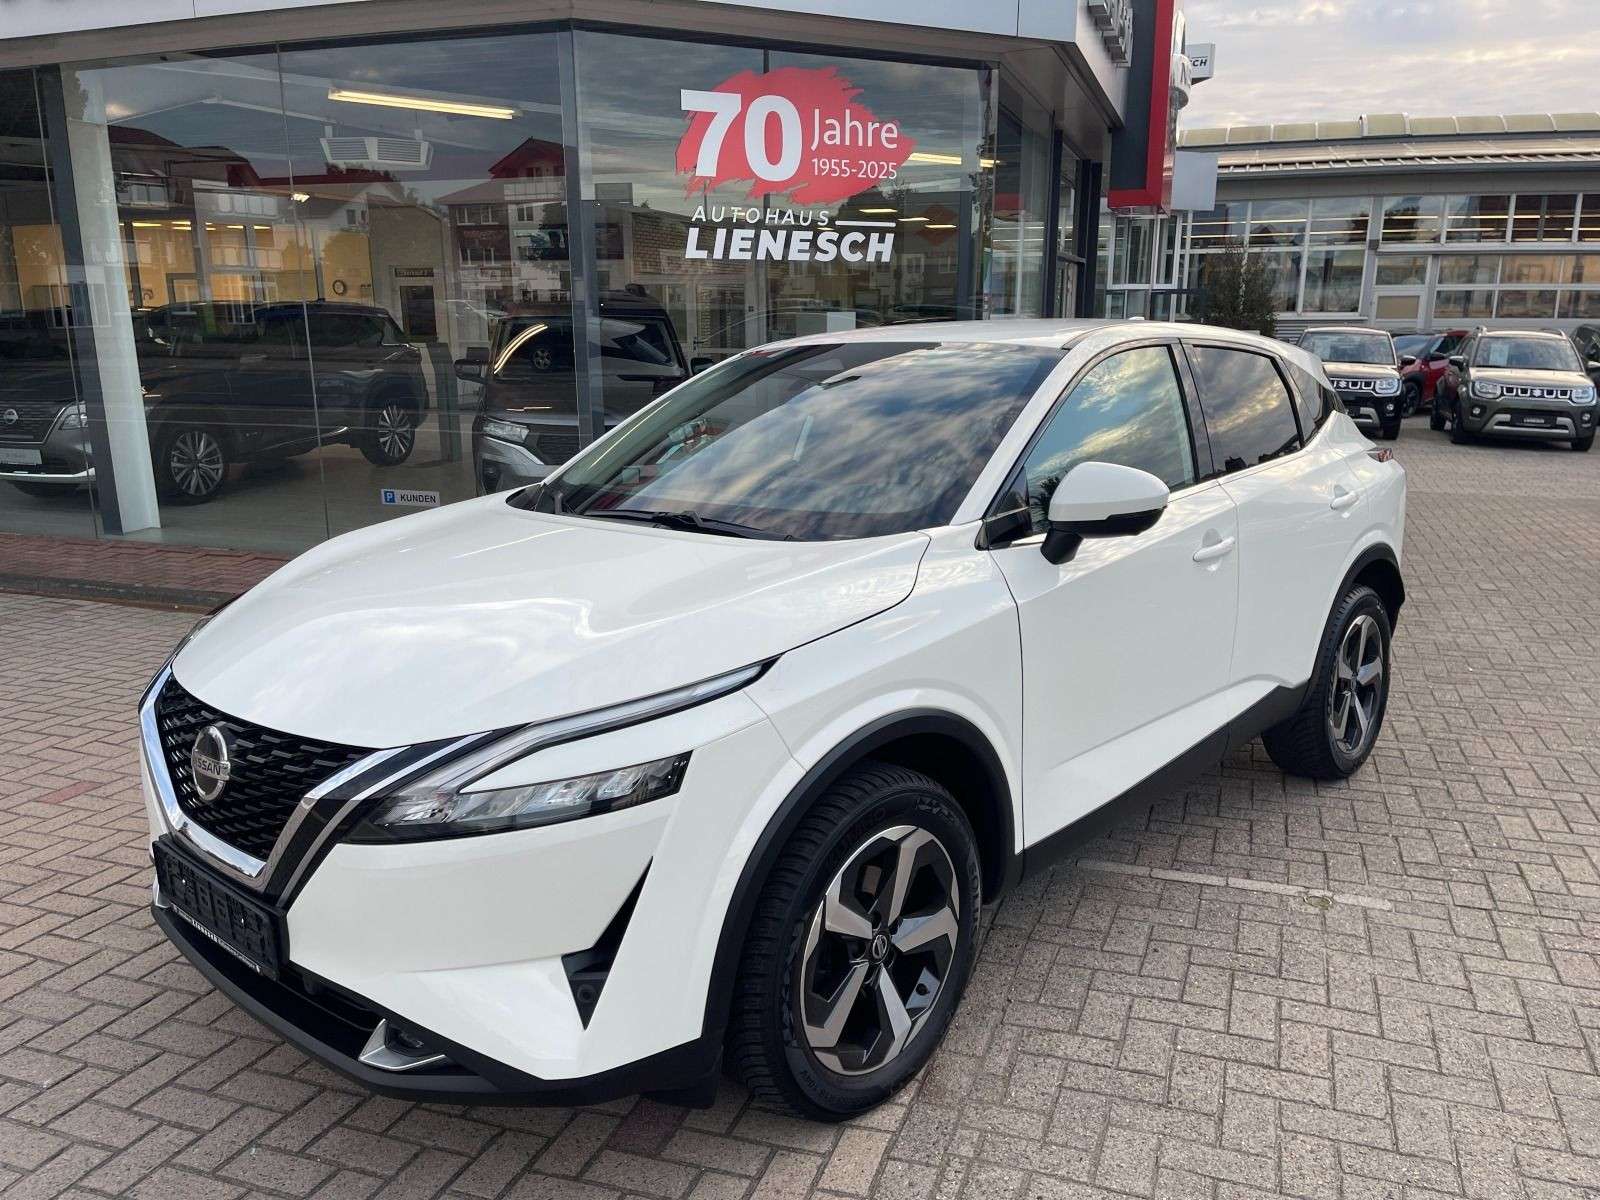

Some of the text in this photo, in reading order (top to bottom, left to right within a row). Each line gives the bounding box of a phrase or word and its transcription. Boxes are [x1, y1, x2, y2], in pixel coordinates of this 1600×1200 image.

[681, 88, 802, 182] 70
[811, 108, 898, 151] Jahre
[811, 158, 897, 180] 1955-2025
[692, 205, 829, 227] AUTOHAUS
[685, 228, 895, 263] LIENESCH
[400, 494, 436, 503] KUNDEN
[192, 753, 221, 776] NISSAN
